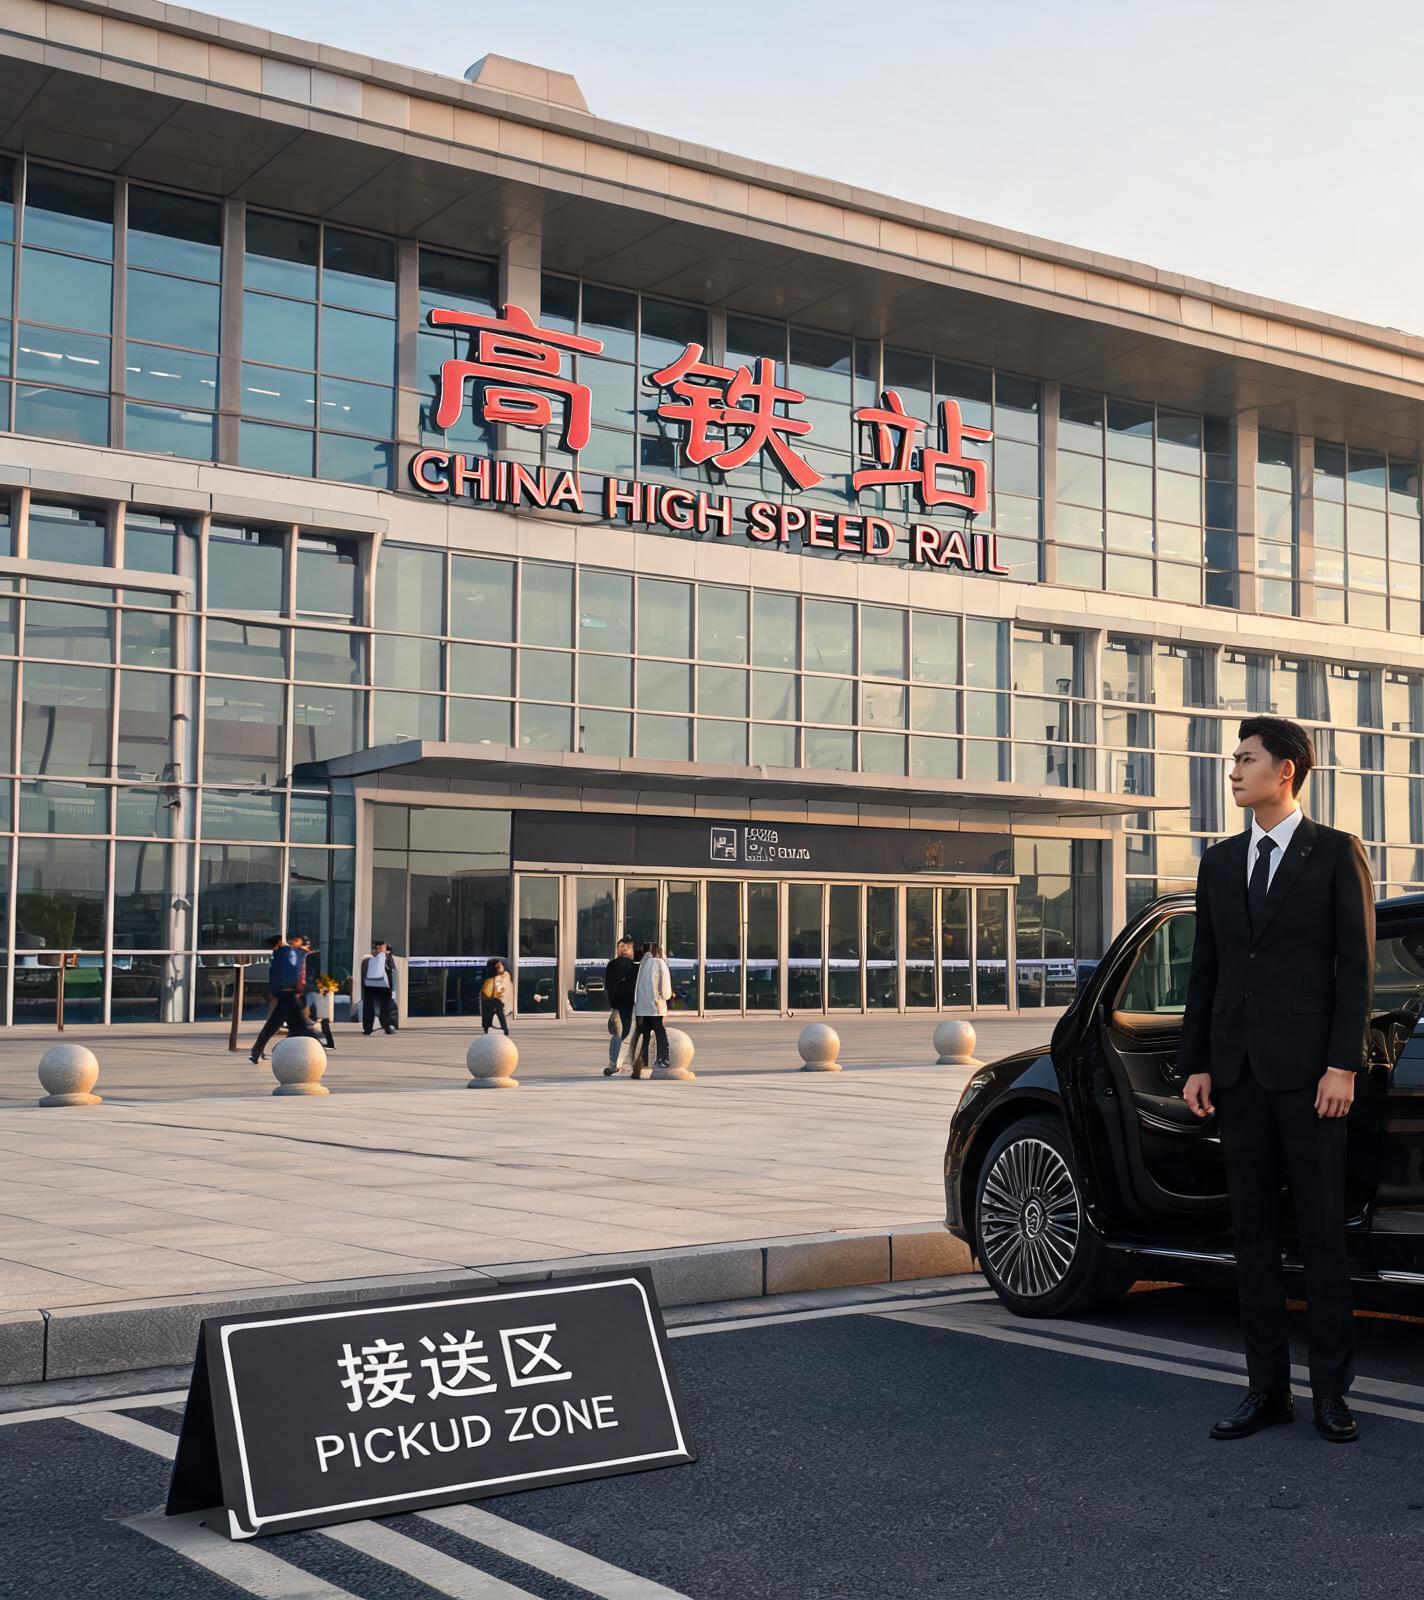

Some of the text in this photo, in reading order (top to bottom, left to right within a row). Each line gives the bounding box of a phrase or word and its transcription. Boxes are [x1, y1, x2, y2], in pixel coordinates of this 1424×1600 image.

[427, 303, 995, 515] 高铁站
[410, 448, 1010, 575] CHINA HIGH SPEED RAIL
[336, 1322, 573, 1413] 接送区
[314, 1394, 619, 1473] PICKUD ZONE
